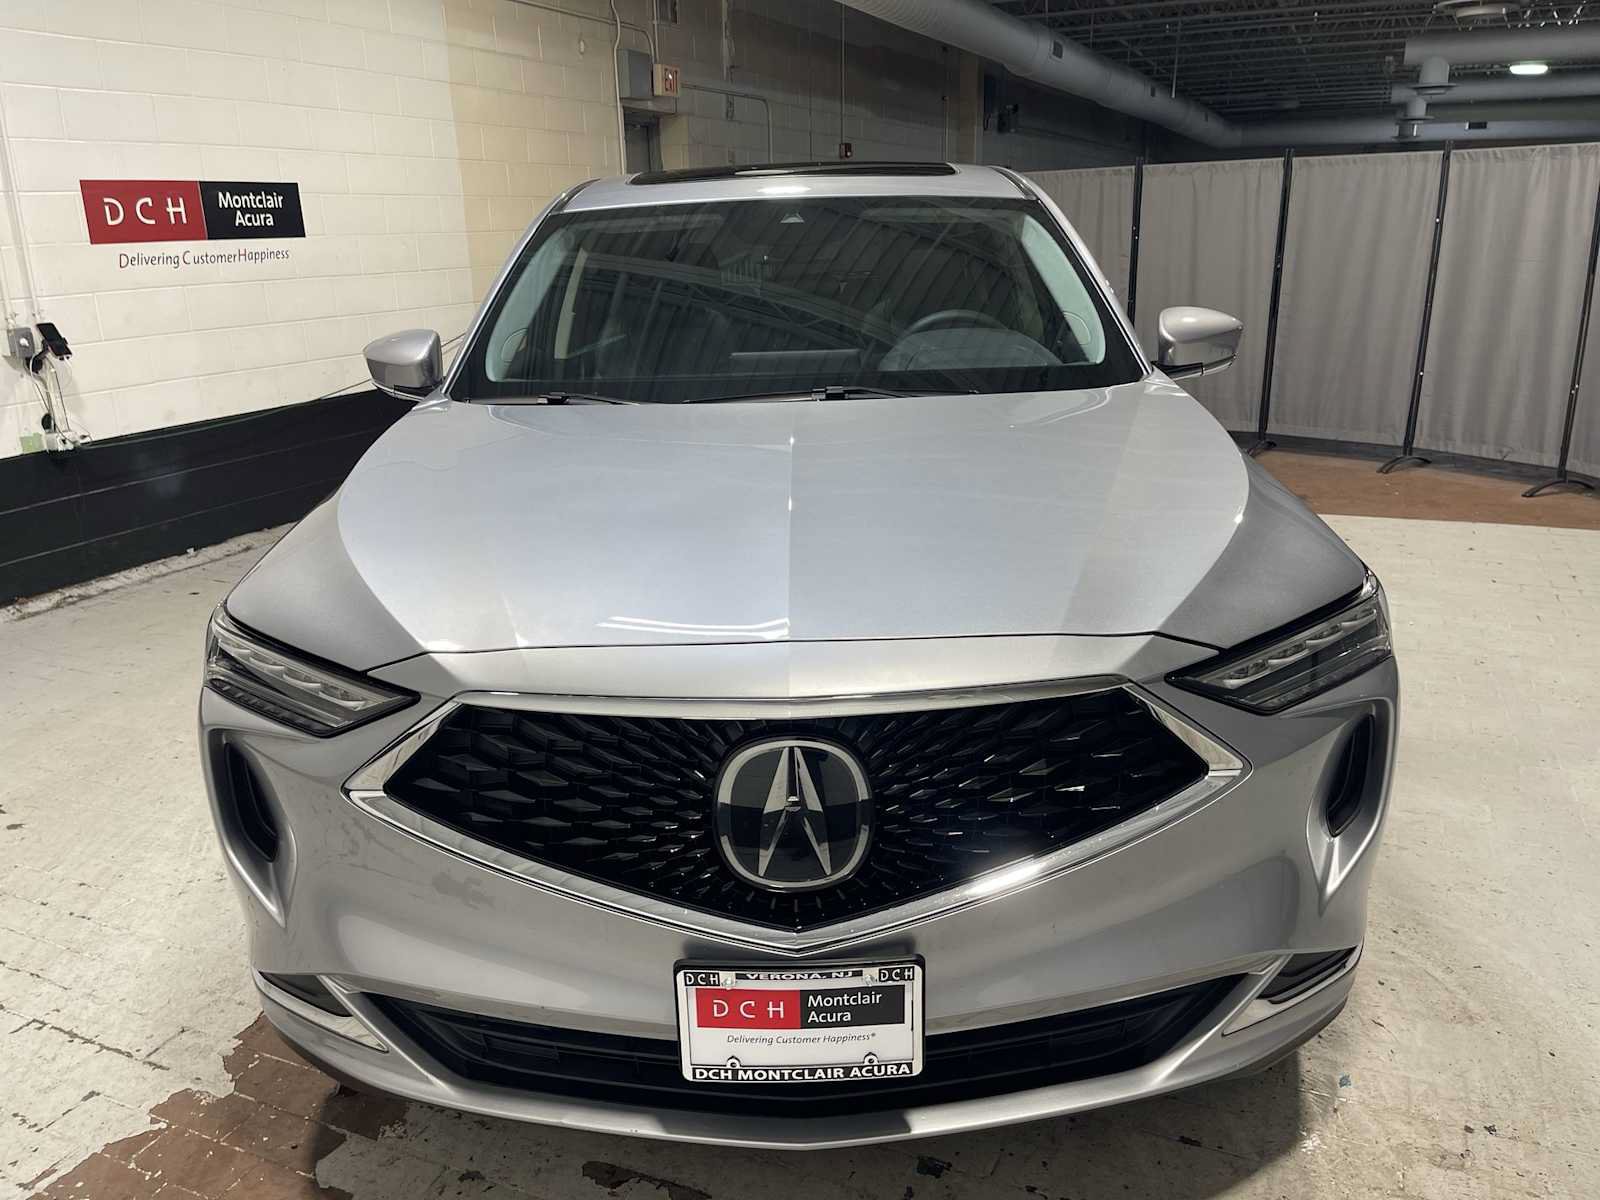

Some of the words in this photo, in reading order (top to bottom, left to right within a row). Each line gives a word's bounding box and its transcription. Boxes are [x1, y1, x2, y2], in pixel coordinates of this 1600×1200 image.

[218, 191, 284, 209] Montclair
[103, 197, 188, 226] DCH
[235, 210, 275, 227] Acura
[119, 252, 180, 269] Delivering
[685, 973, 719, 985] DCH
[880, 968, 914, 982] DCH
[807, 991, 883, 1008] Montclair
[712, 999, 785, 1019] DCH
[807, 1011, 852, 1023] Acura
[727, 1035, 774, 1046] Delivering
[776, 1035, 821, 1045] Customer
[695, 1068, 733, 1080] DCH
[737, 1067, 845, 1081] MONTCLAIR
[849, 1063, 911, 1078] ACURA
